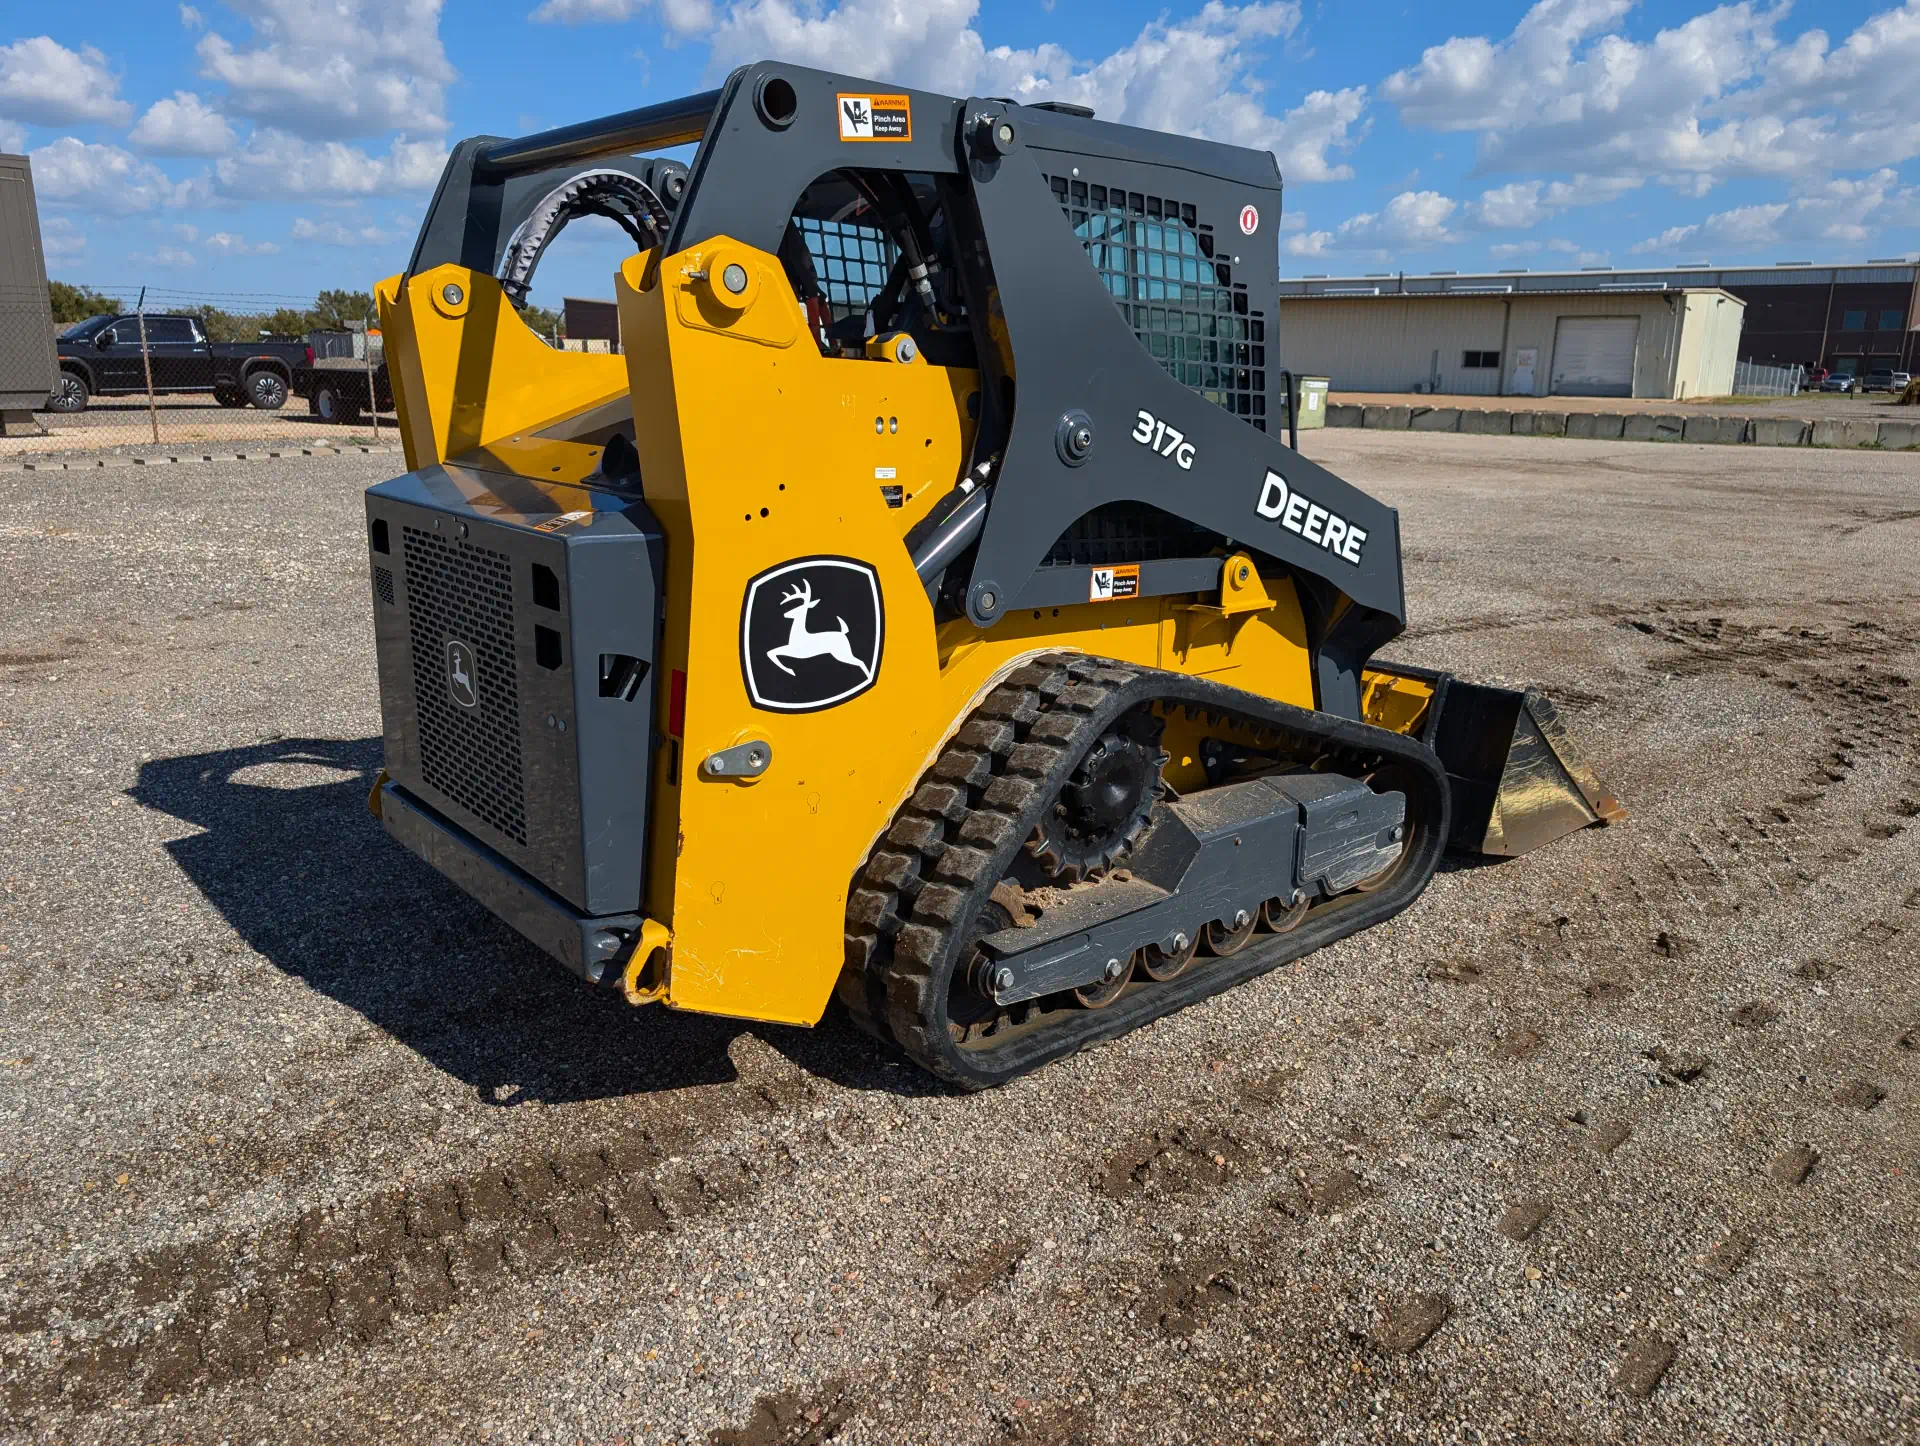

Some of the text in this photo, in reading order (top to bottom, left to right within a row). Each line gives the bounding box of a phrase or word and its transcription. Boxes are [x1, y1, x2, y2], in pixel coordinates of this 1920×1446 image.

[874, 115, 906, 123] Pinch Area
[875, 125, 902, 133] Keep Away
[1132, 410, 1196, 470] 317G
[1256, 471, 1367, 564] DEERE
